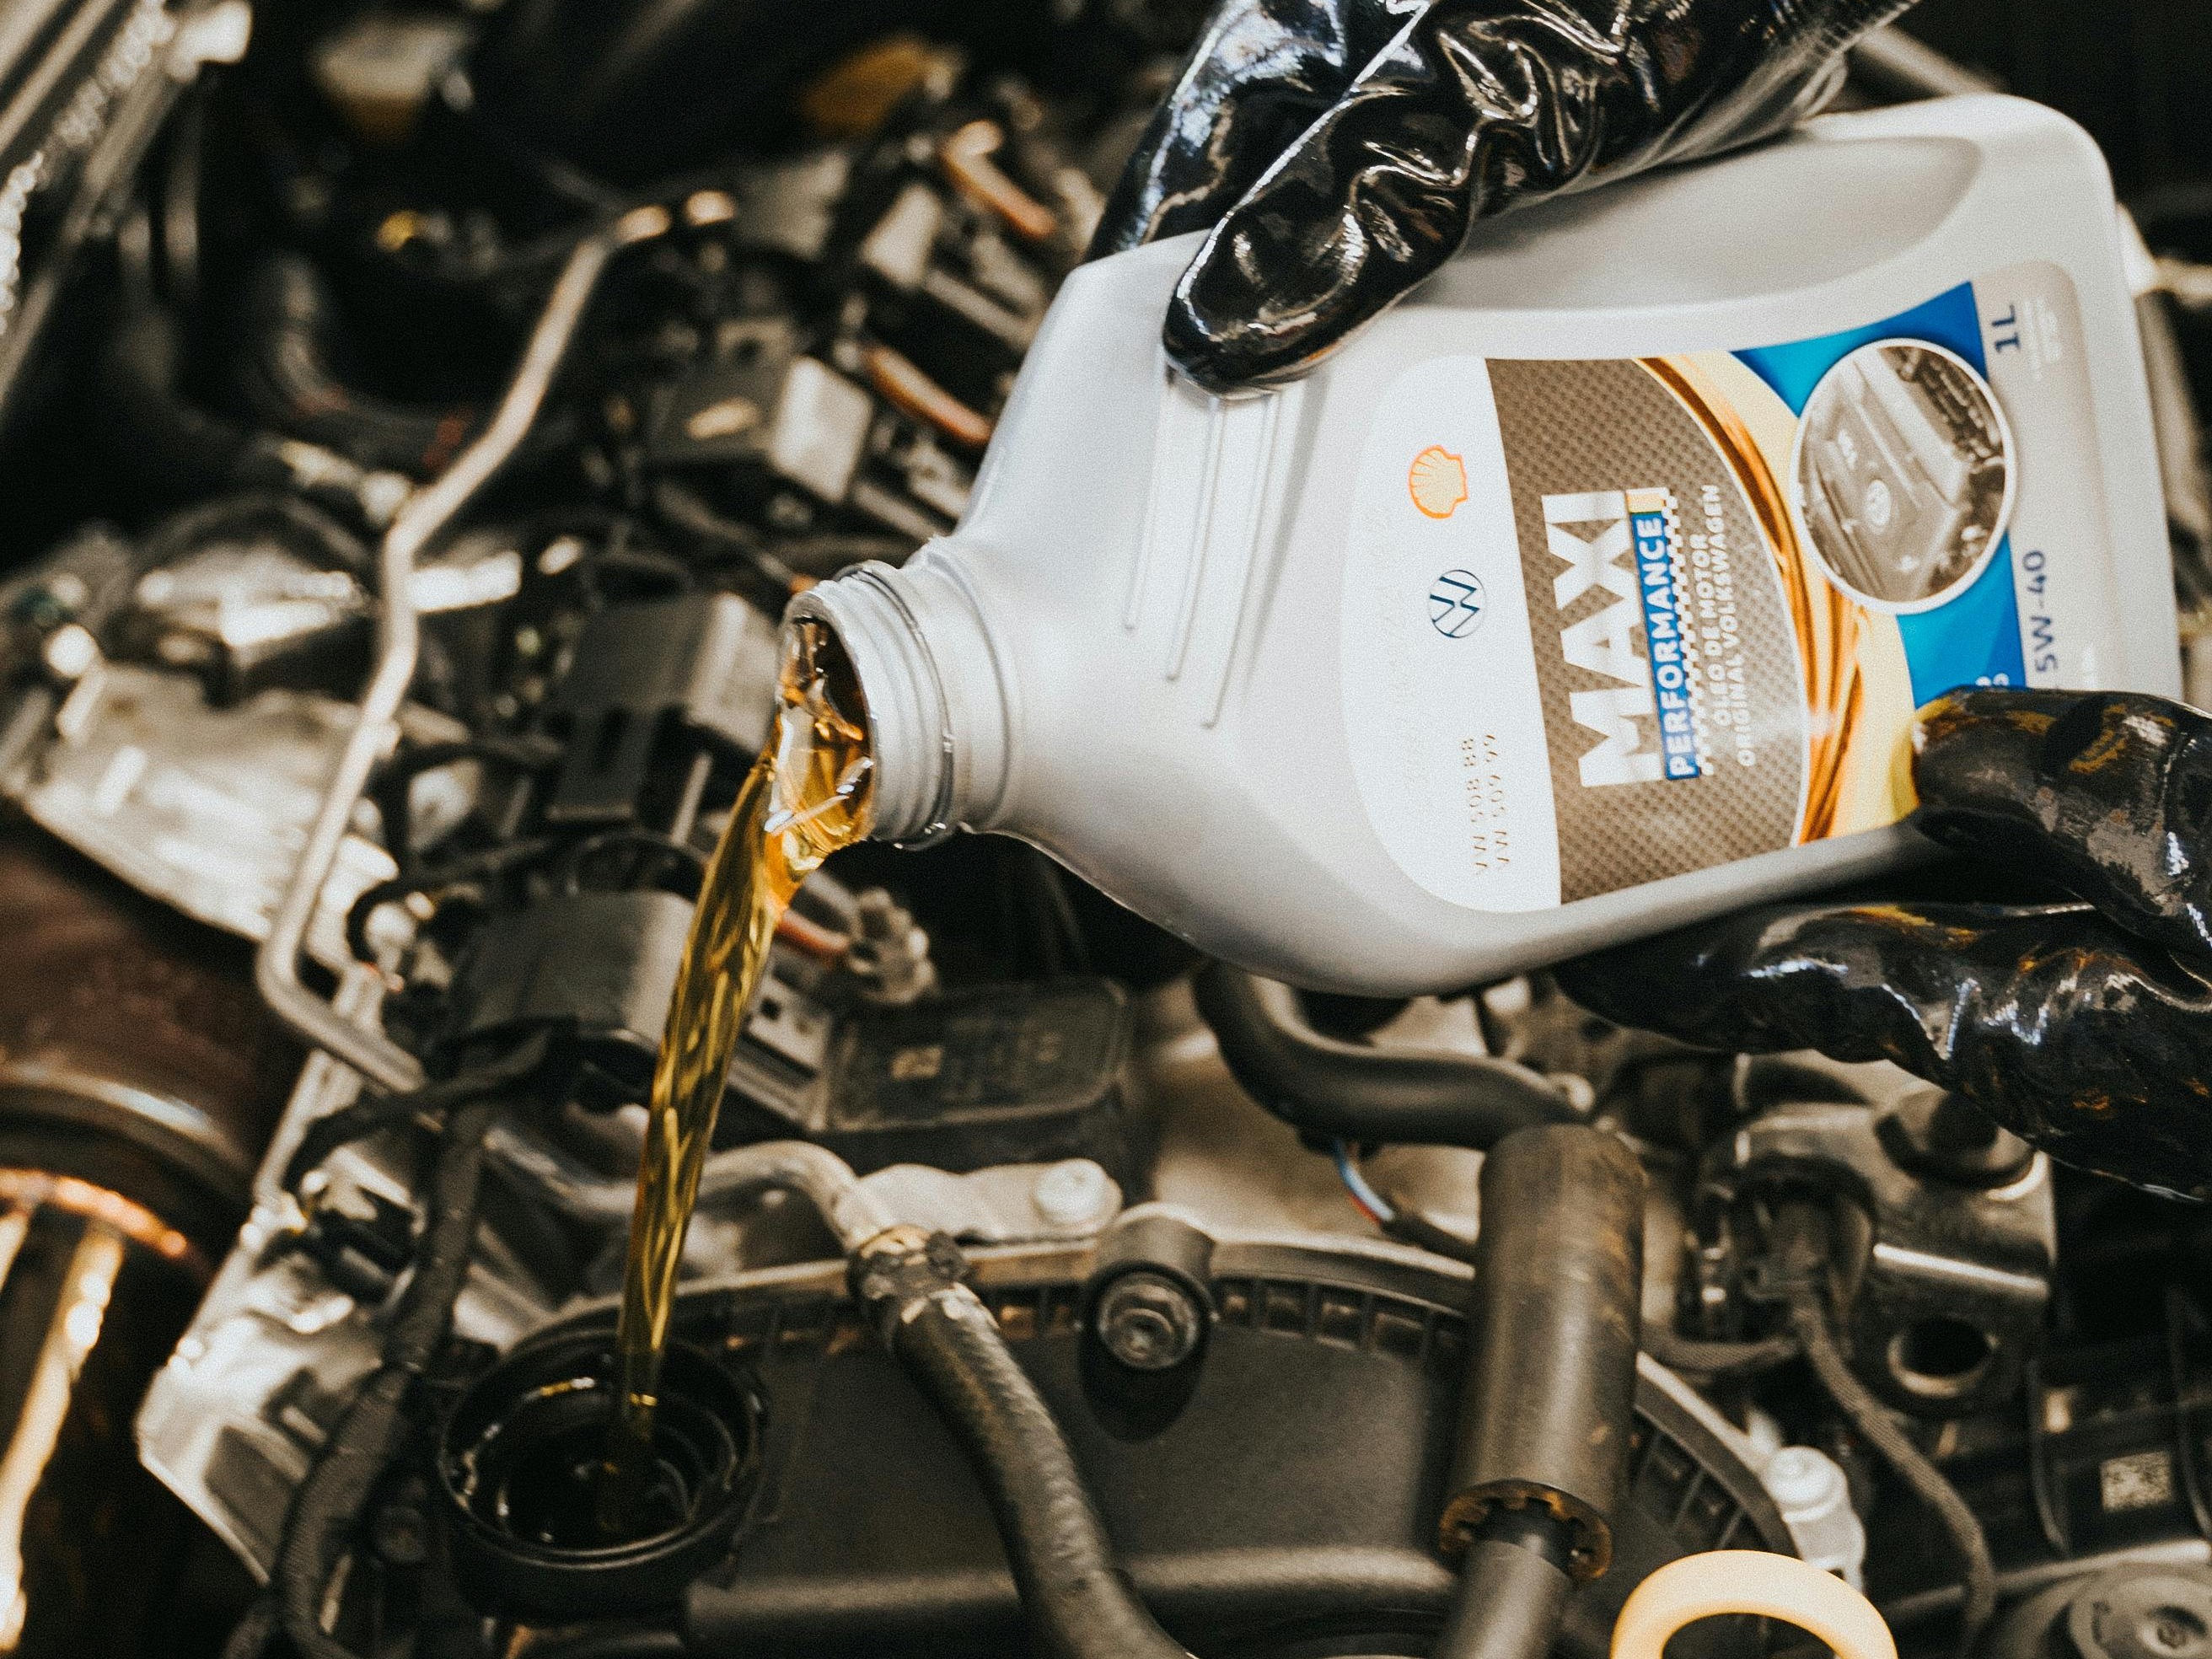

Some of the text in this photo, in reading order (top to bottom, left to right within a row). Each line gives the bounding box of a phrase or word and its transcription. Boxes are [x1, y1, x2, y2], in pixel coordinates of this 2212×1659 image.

[1990, 303, 2021, 354] 1L
[1689, 534, 1718, 619] MOTOR
[1701, 485, 1756, 766] ORIGINAL VOLKSWAGEN
[2022, 550, 2059, 673] 5W-40
[1541, 490, 1665, 787] MAXI
[1636, 517, 1697, 776] PERFORMANCE
[1701, 626, 1723, 657] DE
[1460, 737, 1489, 876] VW 508 88
[1491, 829, 1510, 872] VW
